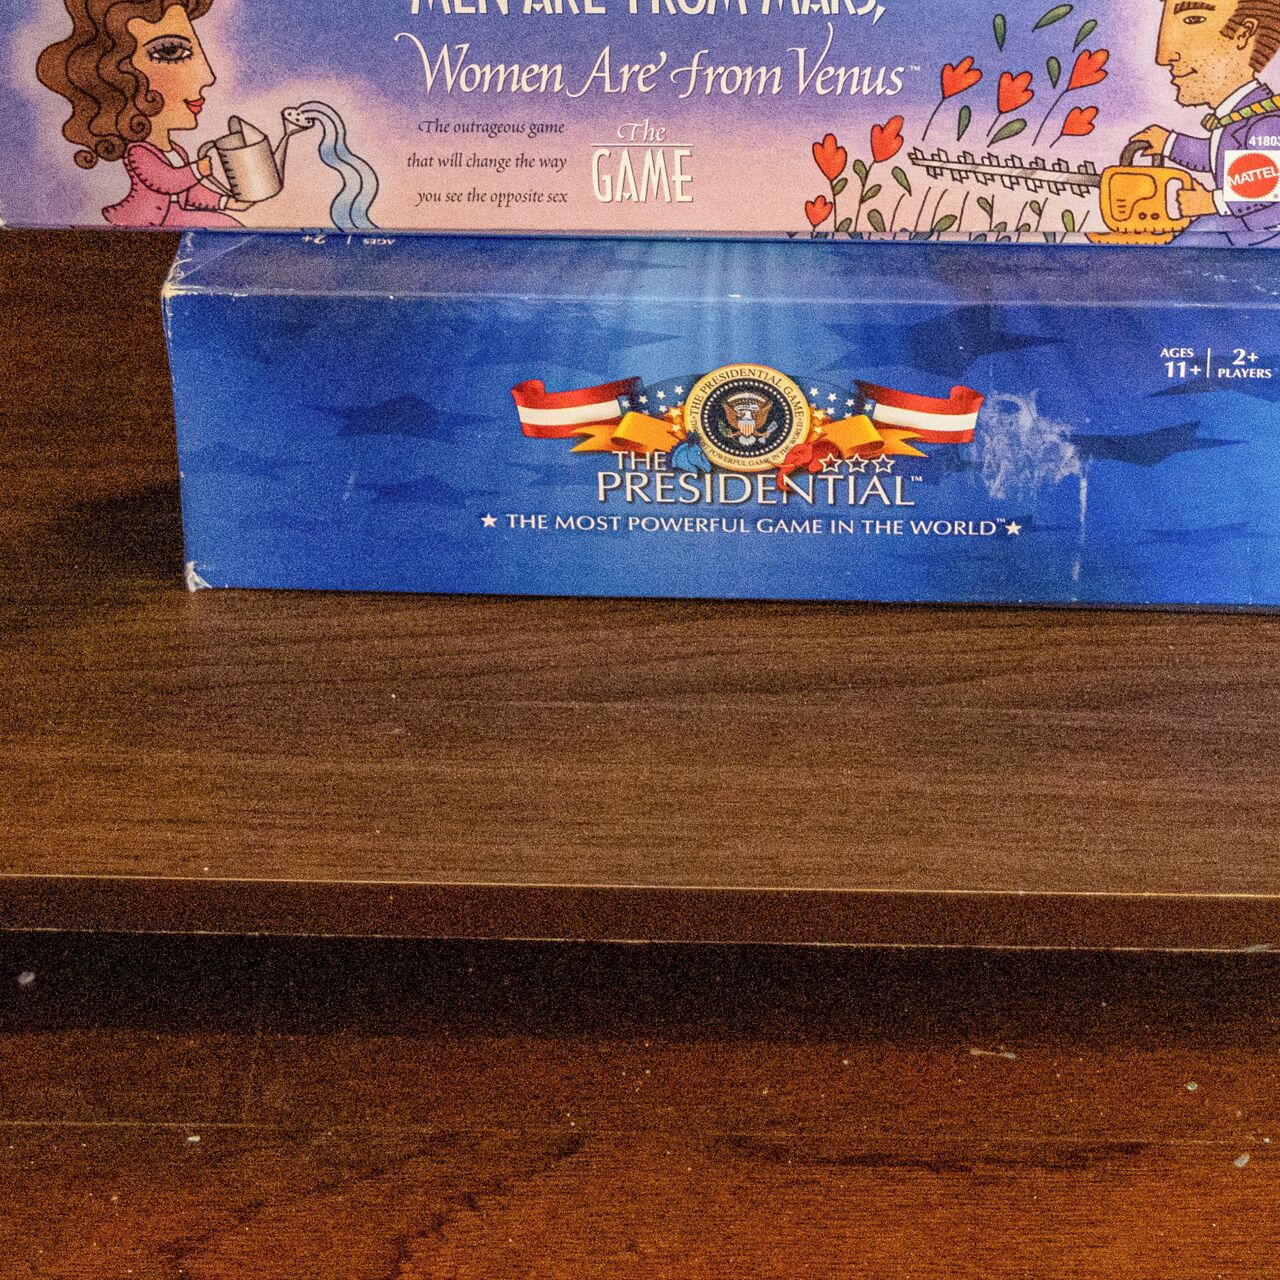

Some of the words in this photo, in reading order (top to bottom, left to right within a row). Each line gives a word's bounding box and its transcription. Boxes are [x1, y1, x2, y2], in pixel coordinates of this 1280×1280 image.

[393, 32, 566, 95] Women
[565, 45, 668, 98] Are
[670, 49, 783, 99] from
[786, 21, 905, 97] Venus
[418, 118, 450, 134] The
[453, 121, 526, 139] outrageous
[528, 122, 565, 139] game
[616, 118, 667, 143] The
[407, 153, 435, 168] that
[437, 152, 463, 168] will
[466, 152, 513, 173] change
[515, 152, 535, 168] the
[539, 157, 567, 172] way
[591, 147, 694, 203] GAME
[1227, 165, 1280, 187] MATTEL
[415, 191, 442, 207] you
[445, 191, 464, 203] see
[467, 187, 487, 203] the
[490, 188, 545, 207] opposite
[547, 191, 568, 203] sex
[1160, 347, 1195, 358] AGES
[1232, 348, 1259, 365] 2+
[1165, 360, 1201, 378] 11+
[1217, 368, 1272, 379] PLAYERS
[689, 395, 704, 415] THE
[701, 368, 782, 395] PRESIDENTIAL
[783, 386, 805, 417] GAME
[612, 450, 667, 471] THE
[598, 472, 915, 506] PRESIDENTIAL
[506, 514, 548, 530] THE
[555, 515, 621, 531] MOST
[628, 516, 750, 533] POWERFUL
[756, 518, 822, 534] GAME
[831, 519, 856, 535] IN
[861, 519, 904, 536] THE
[910, 519, 996, 536] WORLD
